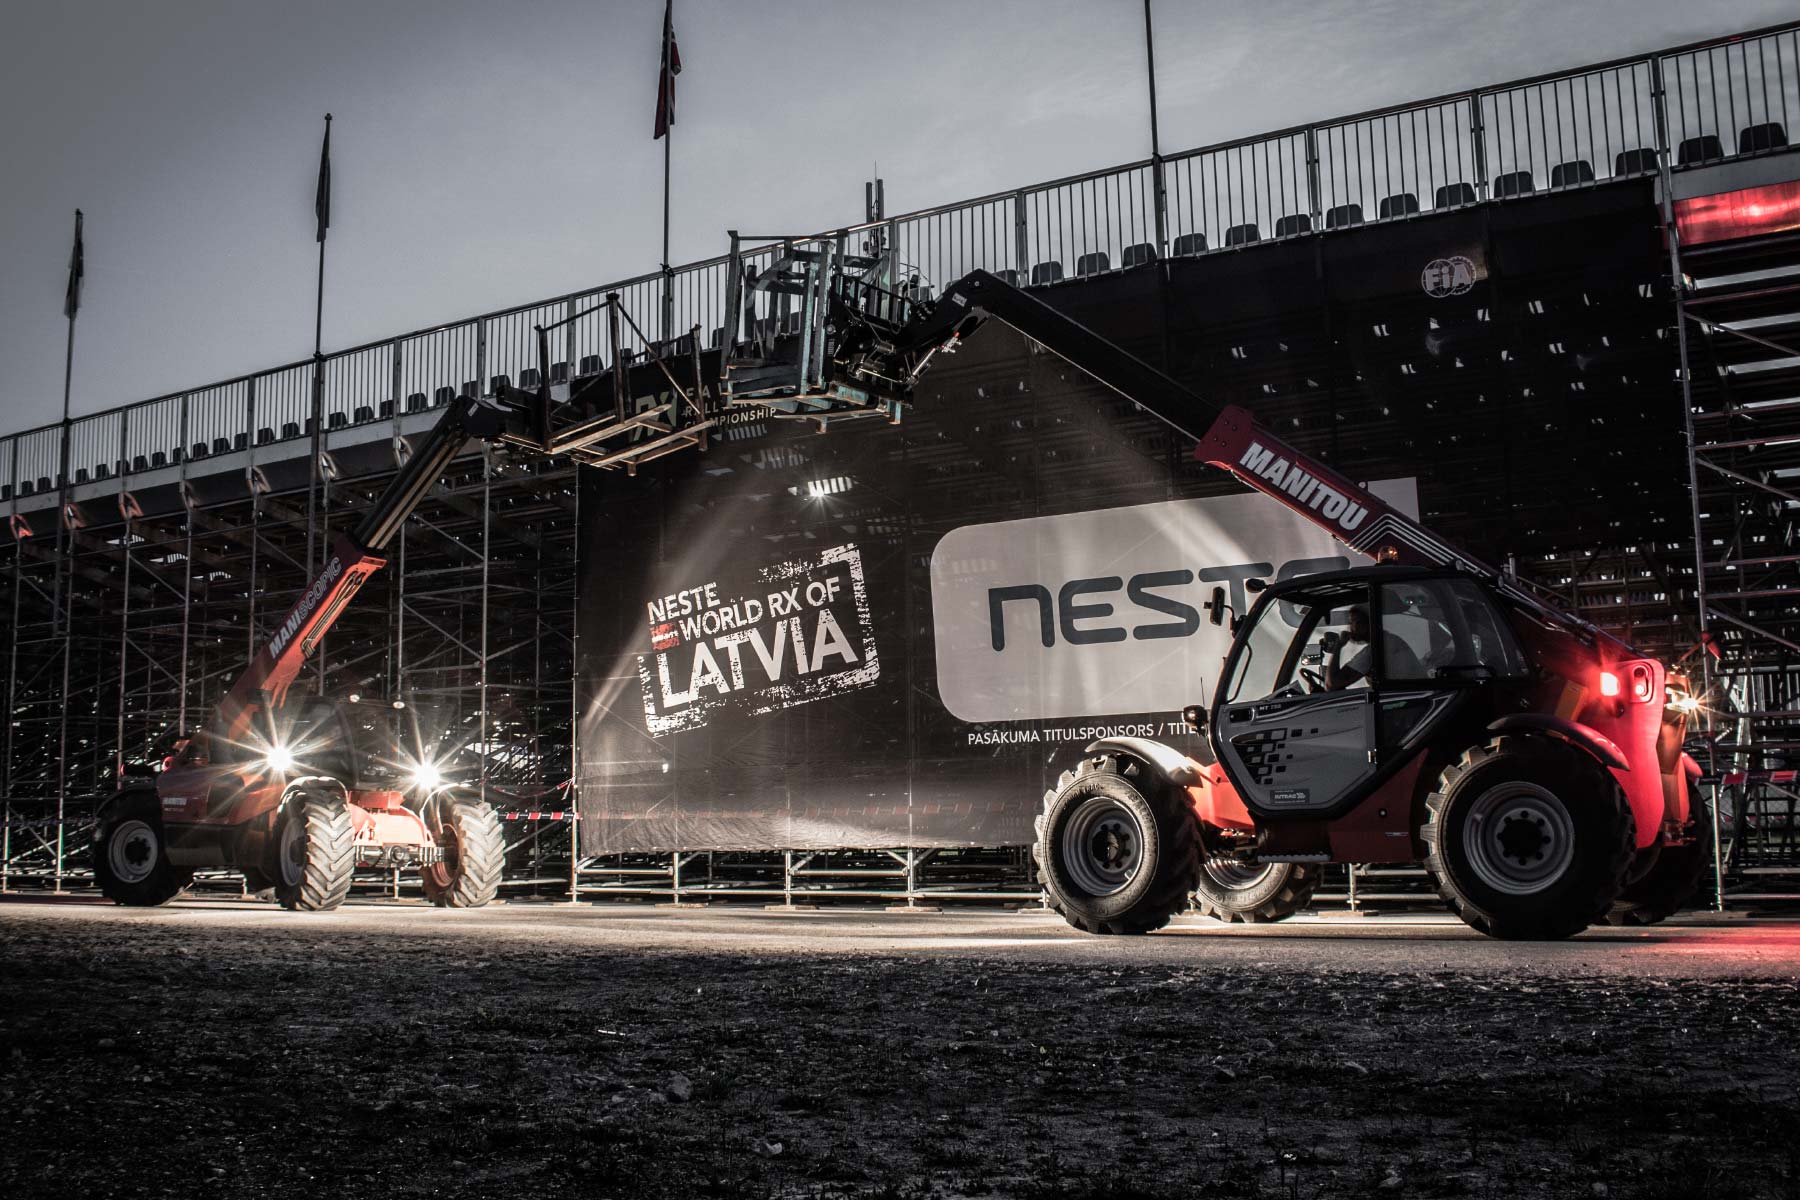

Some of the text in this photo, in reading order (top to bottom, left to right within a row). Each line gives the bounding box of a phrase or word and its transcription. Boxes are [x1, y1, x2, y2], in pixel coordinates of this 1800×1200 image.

[1239, 441, 1369, 531] MANITOU
[268, 556, 342, 659] MANISCOPIC
[648, 582, 721, 625] NESTE
[679, 576, 840, 641] WORLD RX OF
[656, 608, 859, 708] LATVIA
[967, 727, 1041, 746] PASĀKUMA
[1042, 722, 1155, 743] TITULSPONSORS
